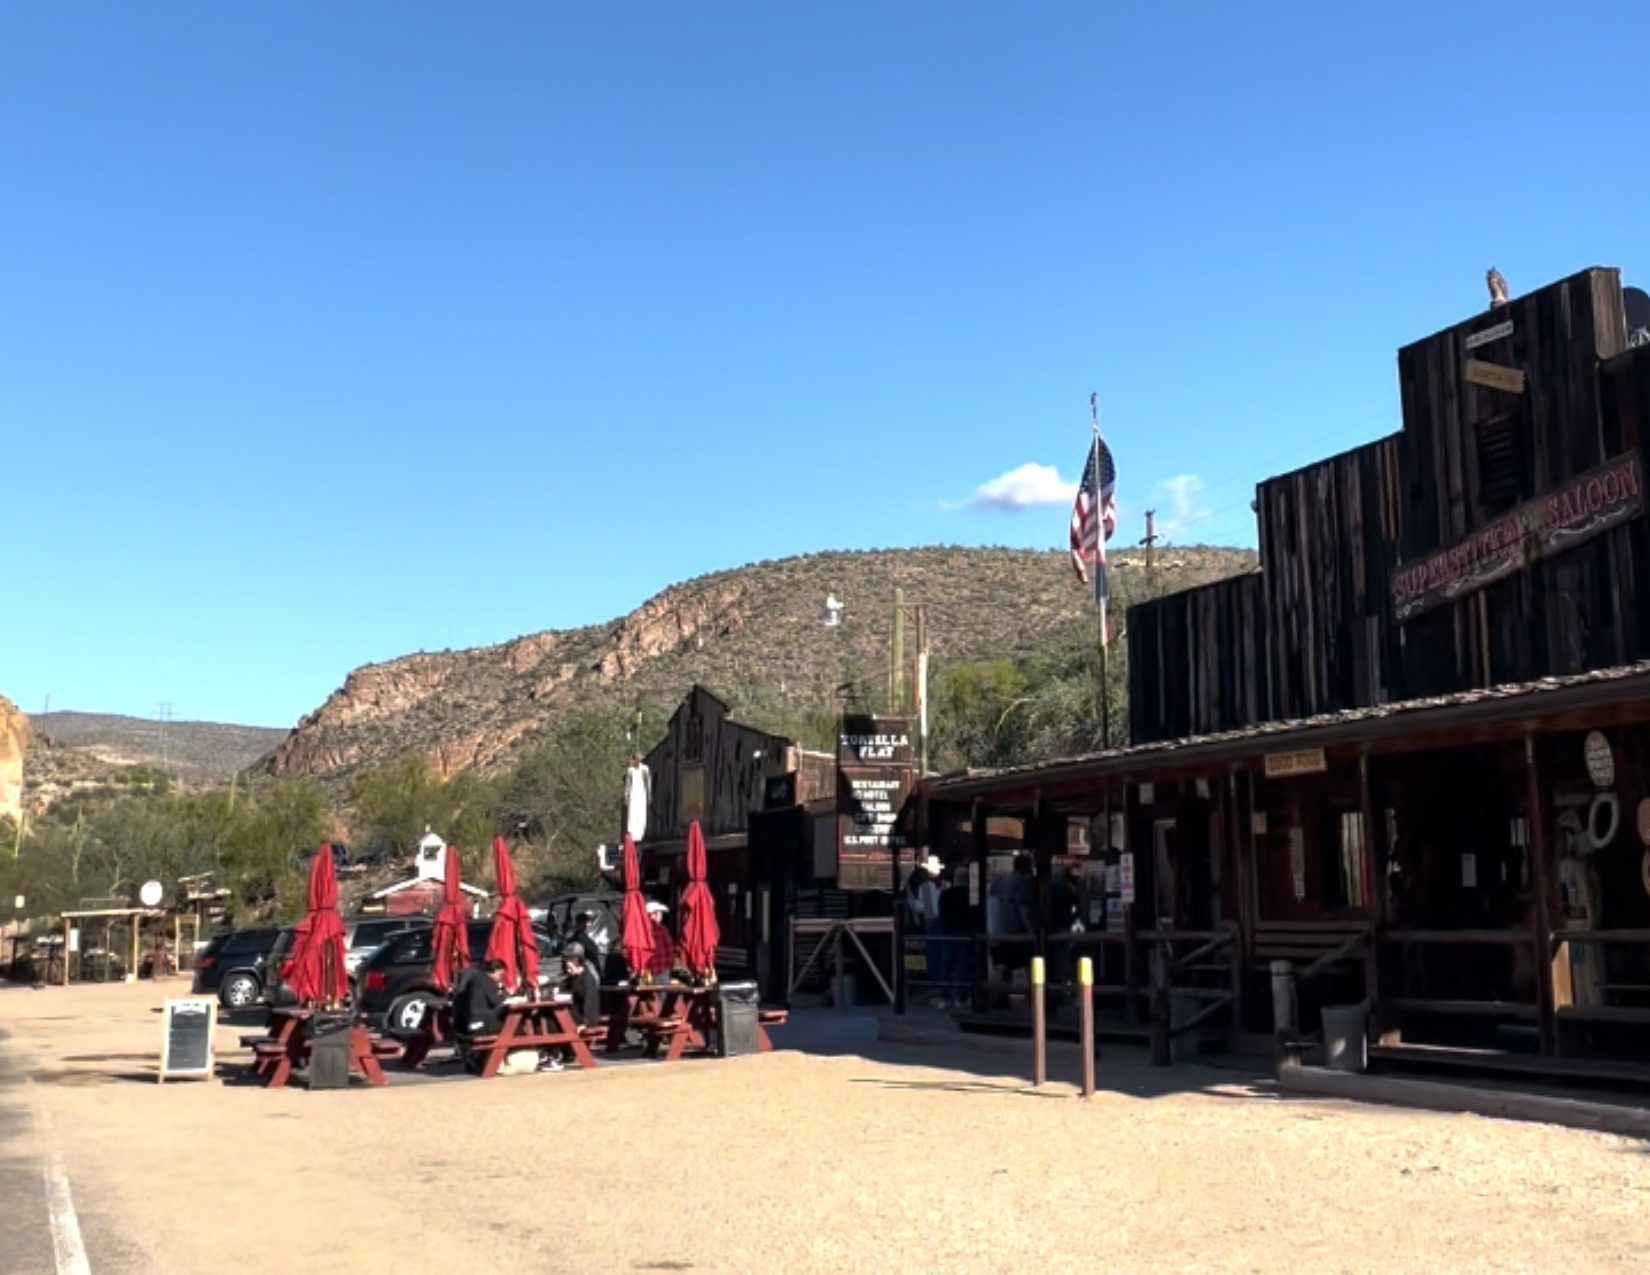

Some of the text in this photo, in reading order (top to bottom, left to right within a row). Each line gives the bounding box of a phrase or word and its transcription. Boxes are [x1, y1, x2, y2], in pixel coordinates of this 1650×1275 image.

[1547, 459, 1639, 530] SALOON
[841, 734, 909, 746] TORTILLA
[859, 745, 895, 758] FLAT
[851, 780, 900, 789] RESTAURANT
